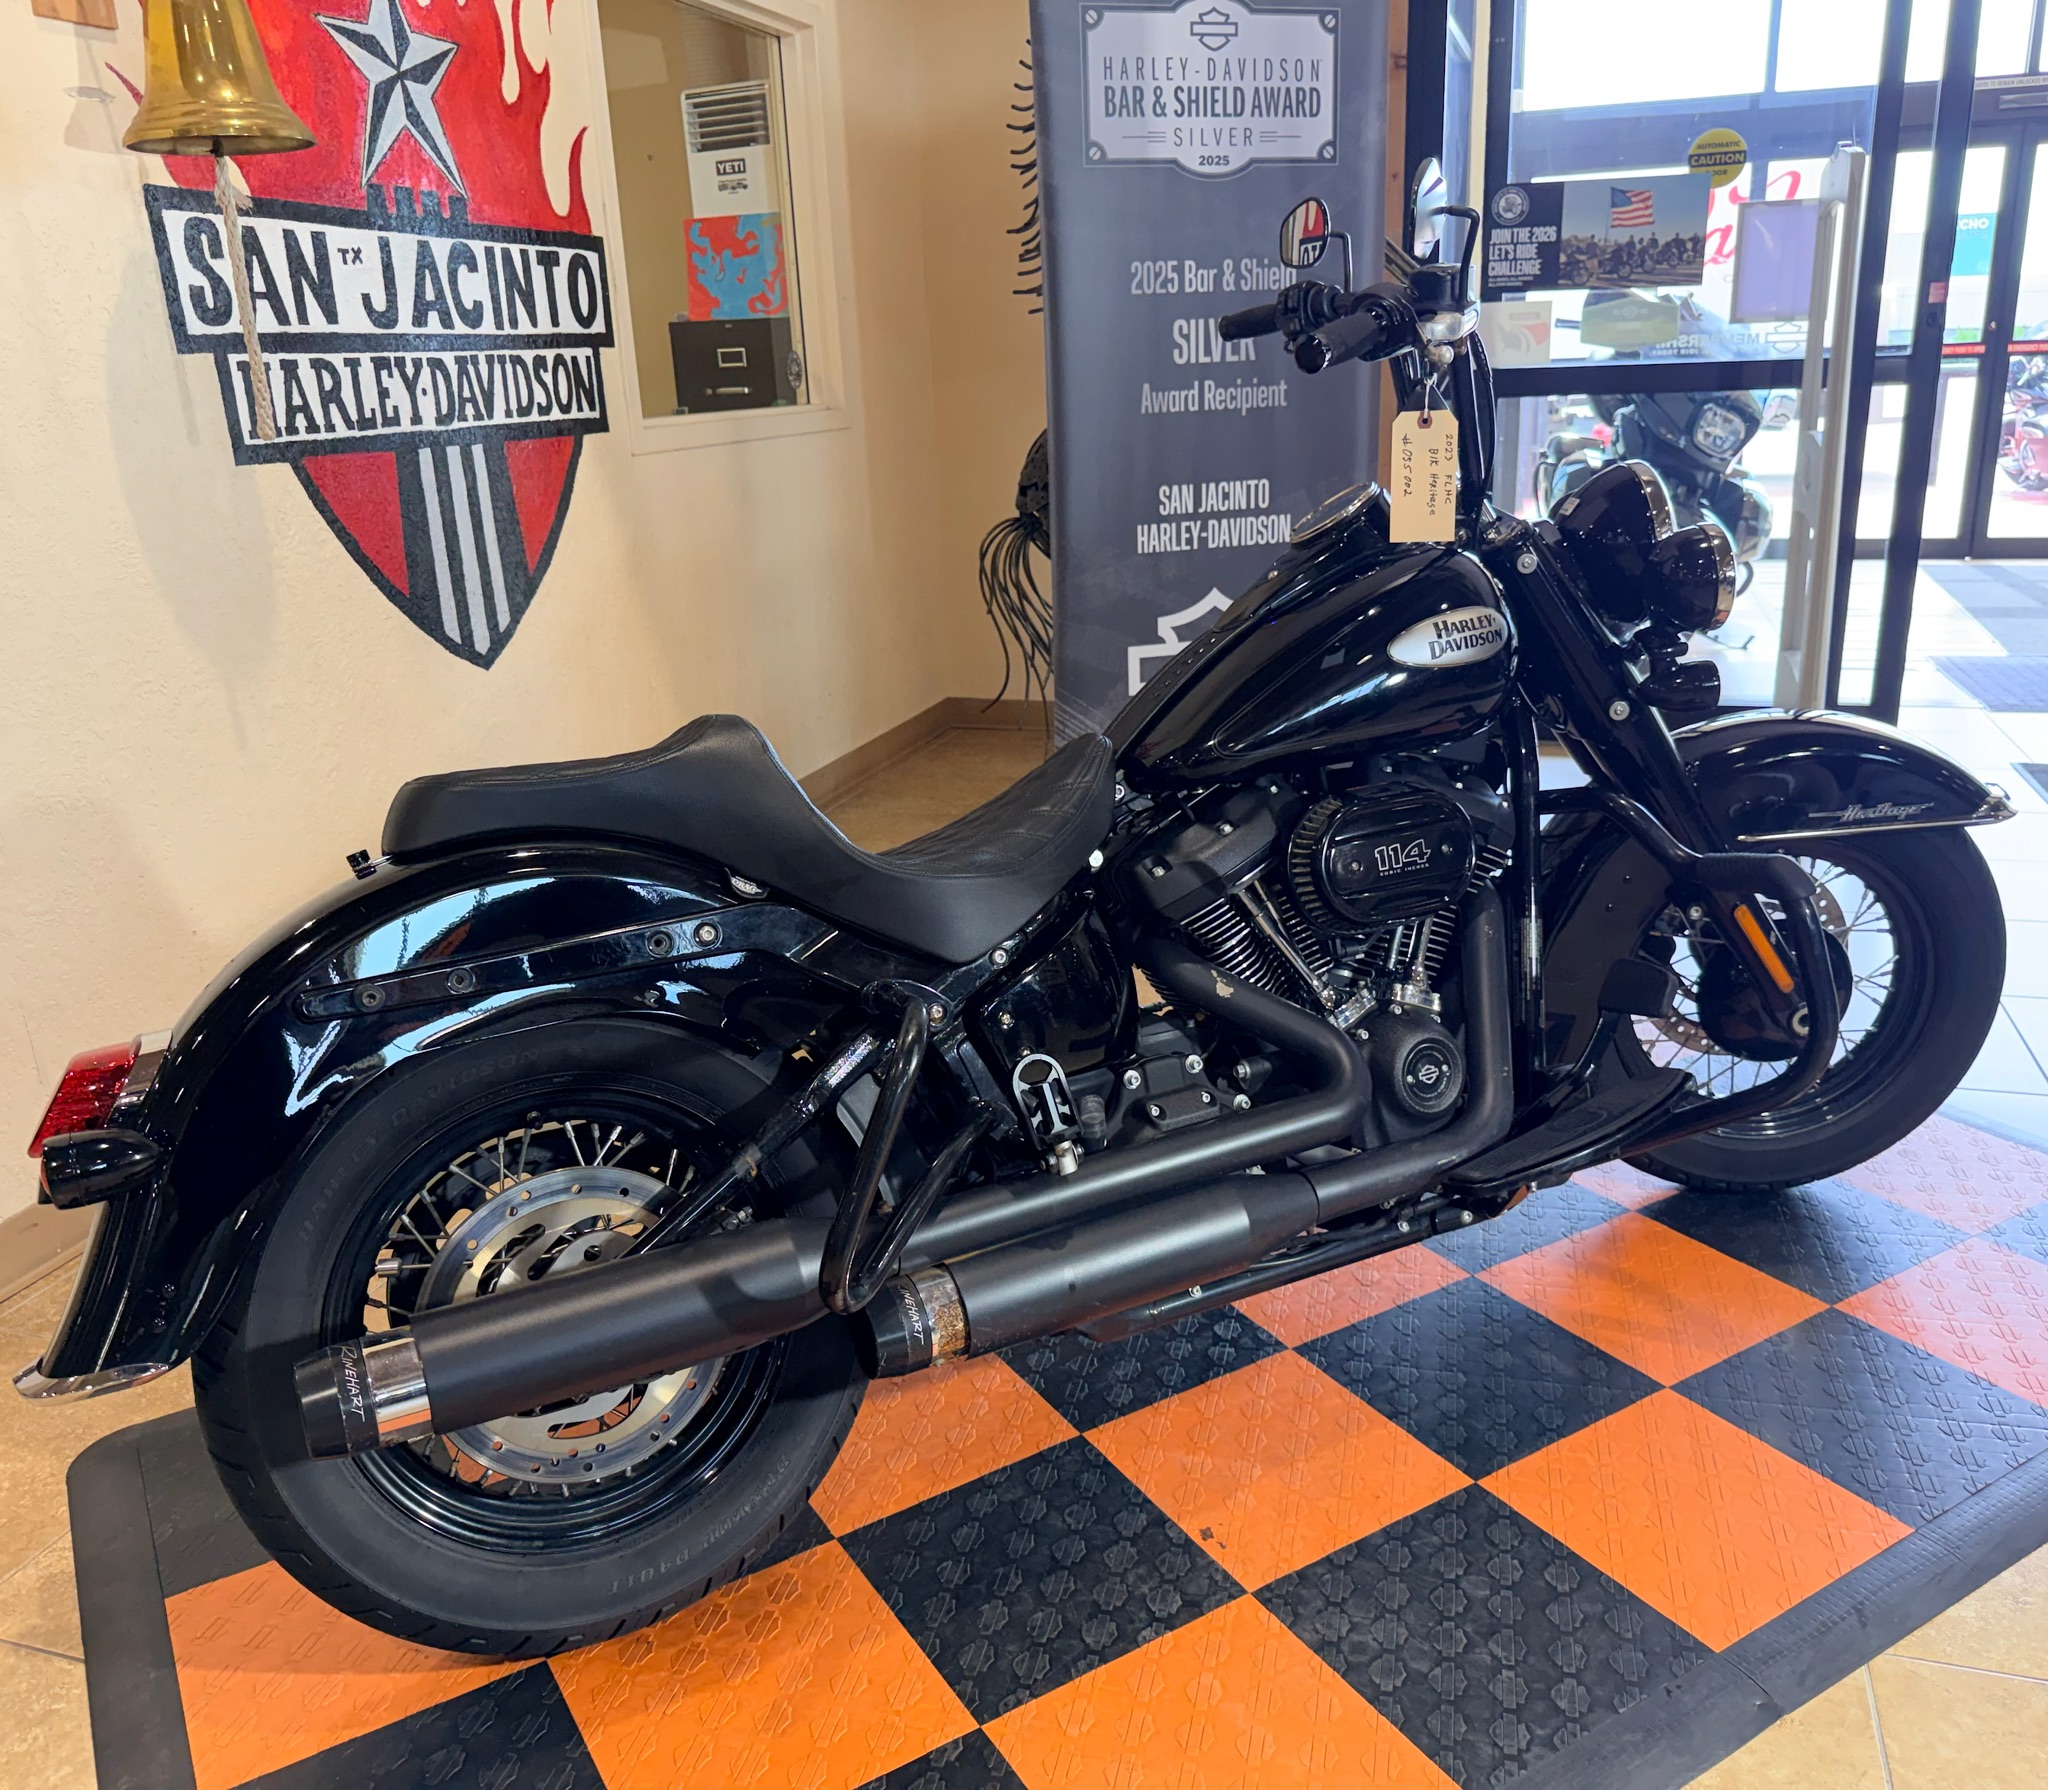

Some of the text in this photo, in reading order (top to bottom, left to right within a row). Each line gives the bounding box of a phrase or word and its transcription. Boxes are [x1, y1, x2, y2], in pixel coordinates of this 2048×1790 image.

[1104, 85, 1322, 118] BAR & SHIELD AWARD
[1173, 127, 1254, 147] SILVER
[1696, 140, 1742, 150] AUTOMATIC
[717, 161, 745, 174] YETI
[1198, 155, 1230, 166] 2025
[1691, 152, 1745, 166] CAUTION
[1489, 227, 1512, 244] JOIN
[1513, 227, 1531, 244] THE
[1957, 217, 1990, 230] CHO
[337, 246, 364, 265] TX
[1516, 243, 1539, 259] RIDE
[183, 216, 598, 330] SAN JACINTO
[1131, 260, 1179, 295] 2025
[1184, 260, 1218, 293] Bar
[1222, 258, 1236, 292] &
[1487, 259, 1543, 276] CHALLENGE
[1141, 378, 1288, 416] Award Recipient
[1444, 433, 1454, 462] 2023
[1158, 478, 1270, 516] SAN JACINTO
[1136, 513, 1292, 554] HARLEY-DAVIDSON
[1428, 628, 1503, 660] DAVIDSON
[1374, 838, 1432, 871] 114
[898, 1285, 925, 1346] INEHART
[340, 1345, 366, 1423] RINEHART
